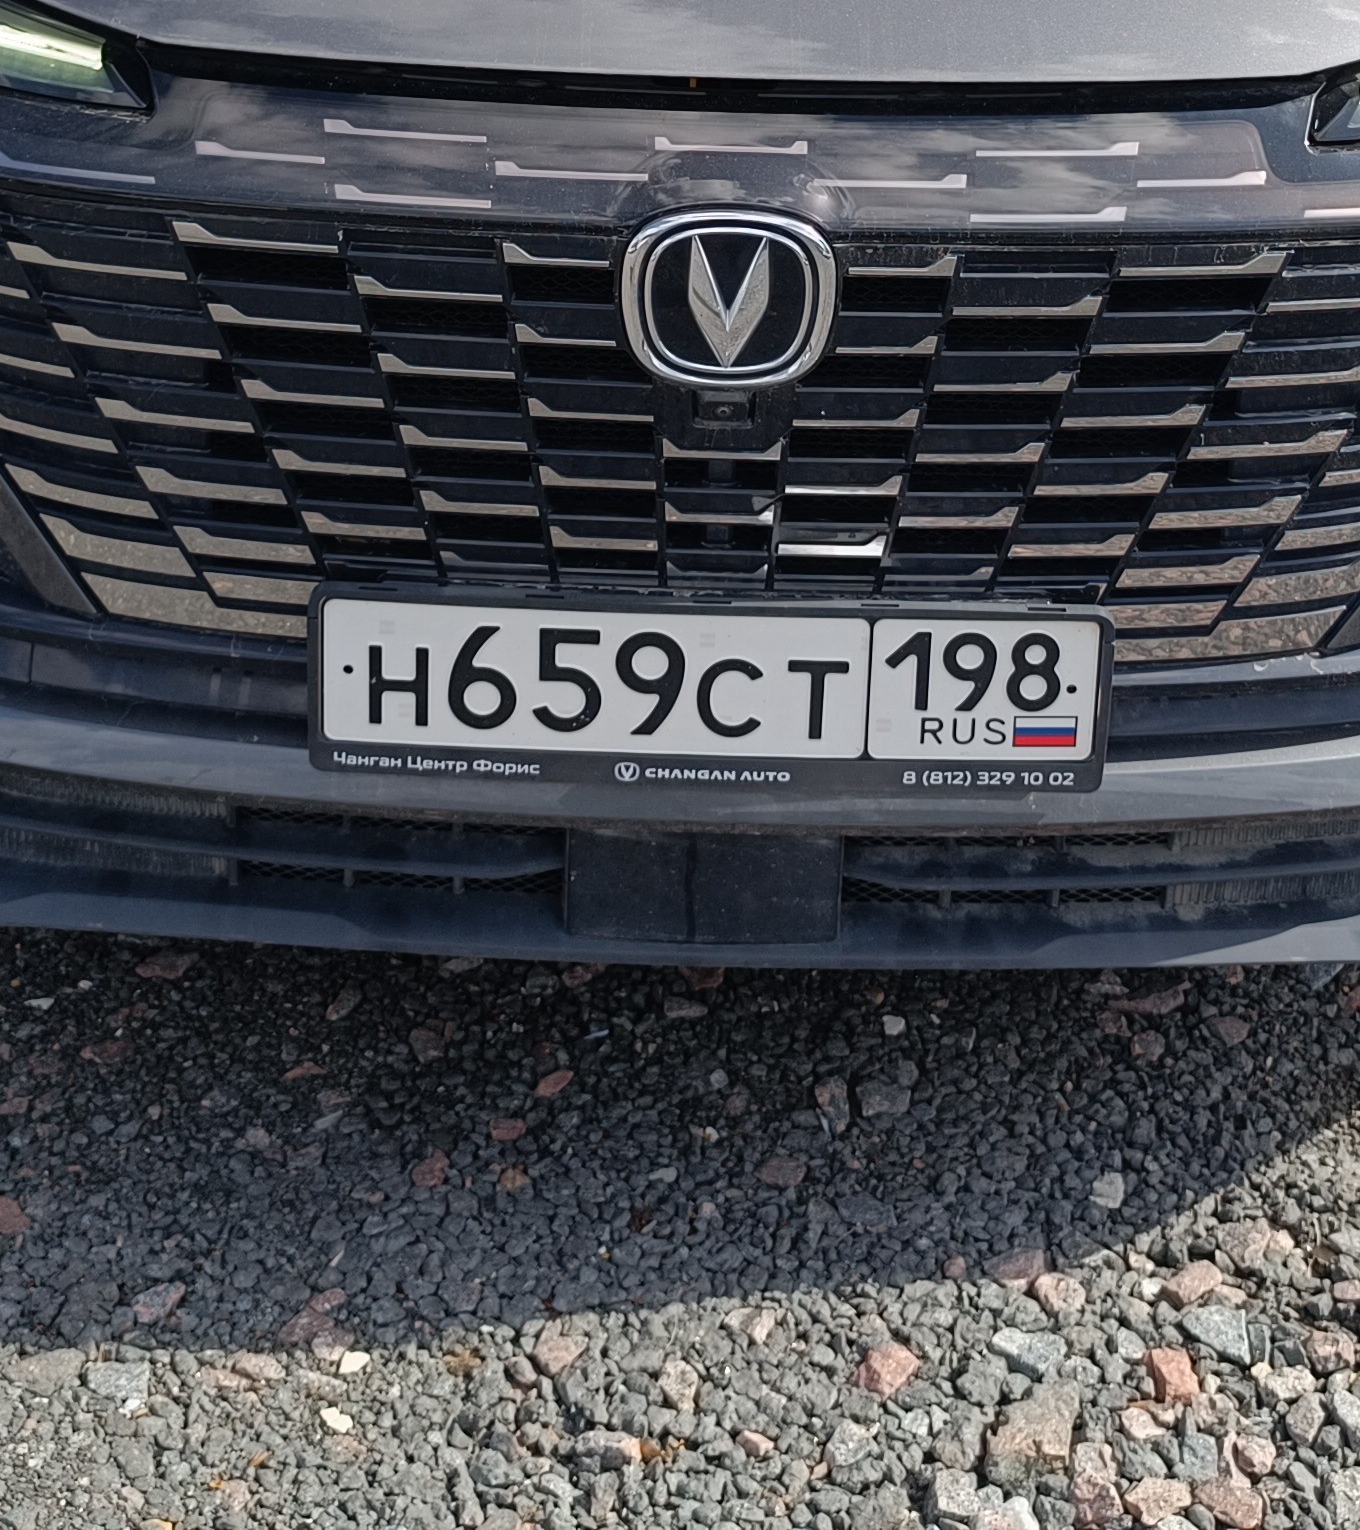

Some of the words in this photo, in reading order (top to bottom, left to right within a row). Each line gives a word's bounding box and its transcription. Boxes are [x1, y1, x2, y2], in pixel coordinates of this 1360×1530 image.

[884, 631, 1061, 712] 198
[920, 716, 1007, 746] RUS
[333, 751, 402, 768] Чанган
[407, 756, 468, 773] Центр
[472, 759, 540, 776] Форис
[644, 768, 736, 781] CHANGAN
[740, 771, 791, 782] AUTO
[902, 771, 916, 785] 8
[922, 771, 972, 786] (812)
[976, 772, 1015, 785] 329
[1020, 772, 1043, 785] 10
[1048, 772, 1074, 785] 02
